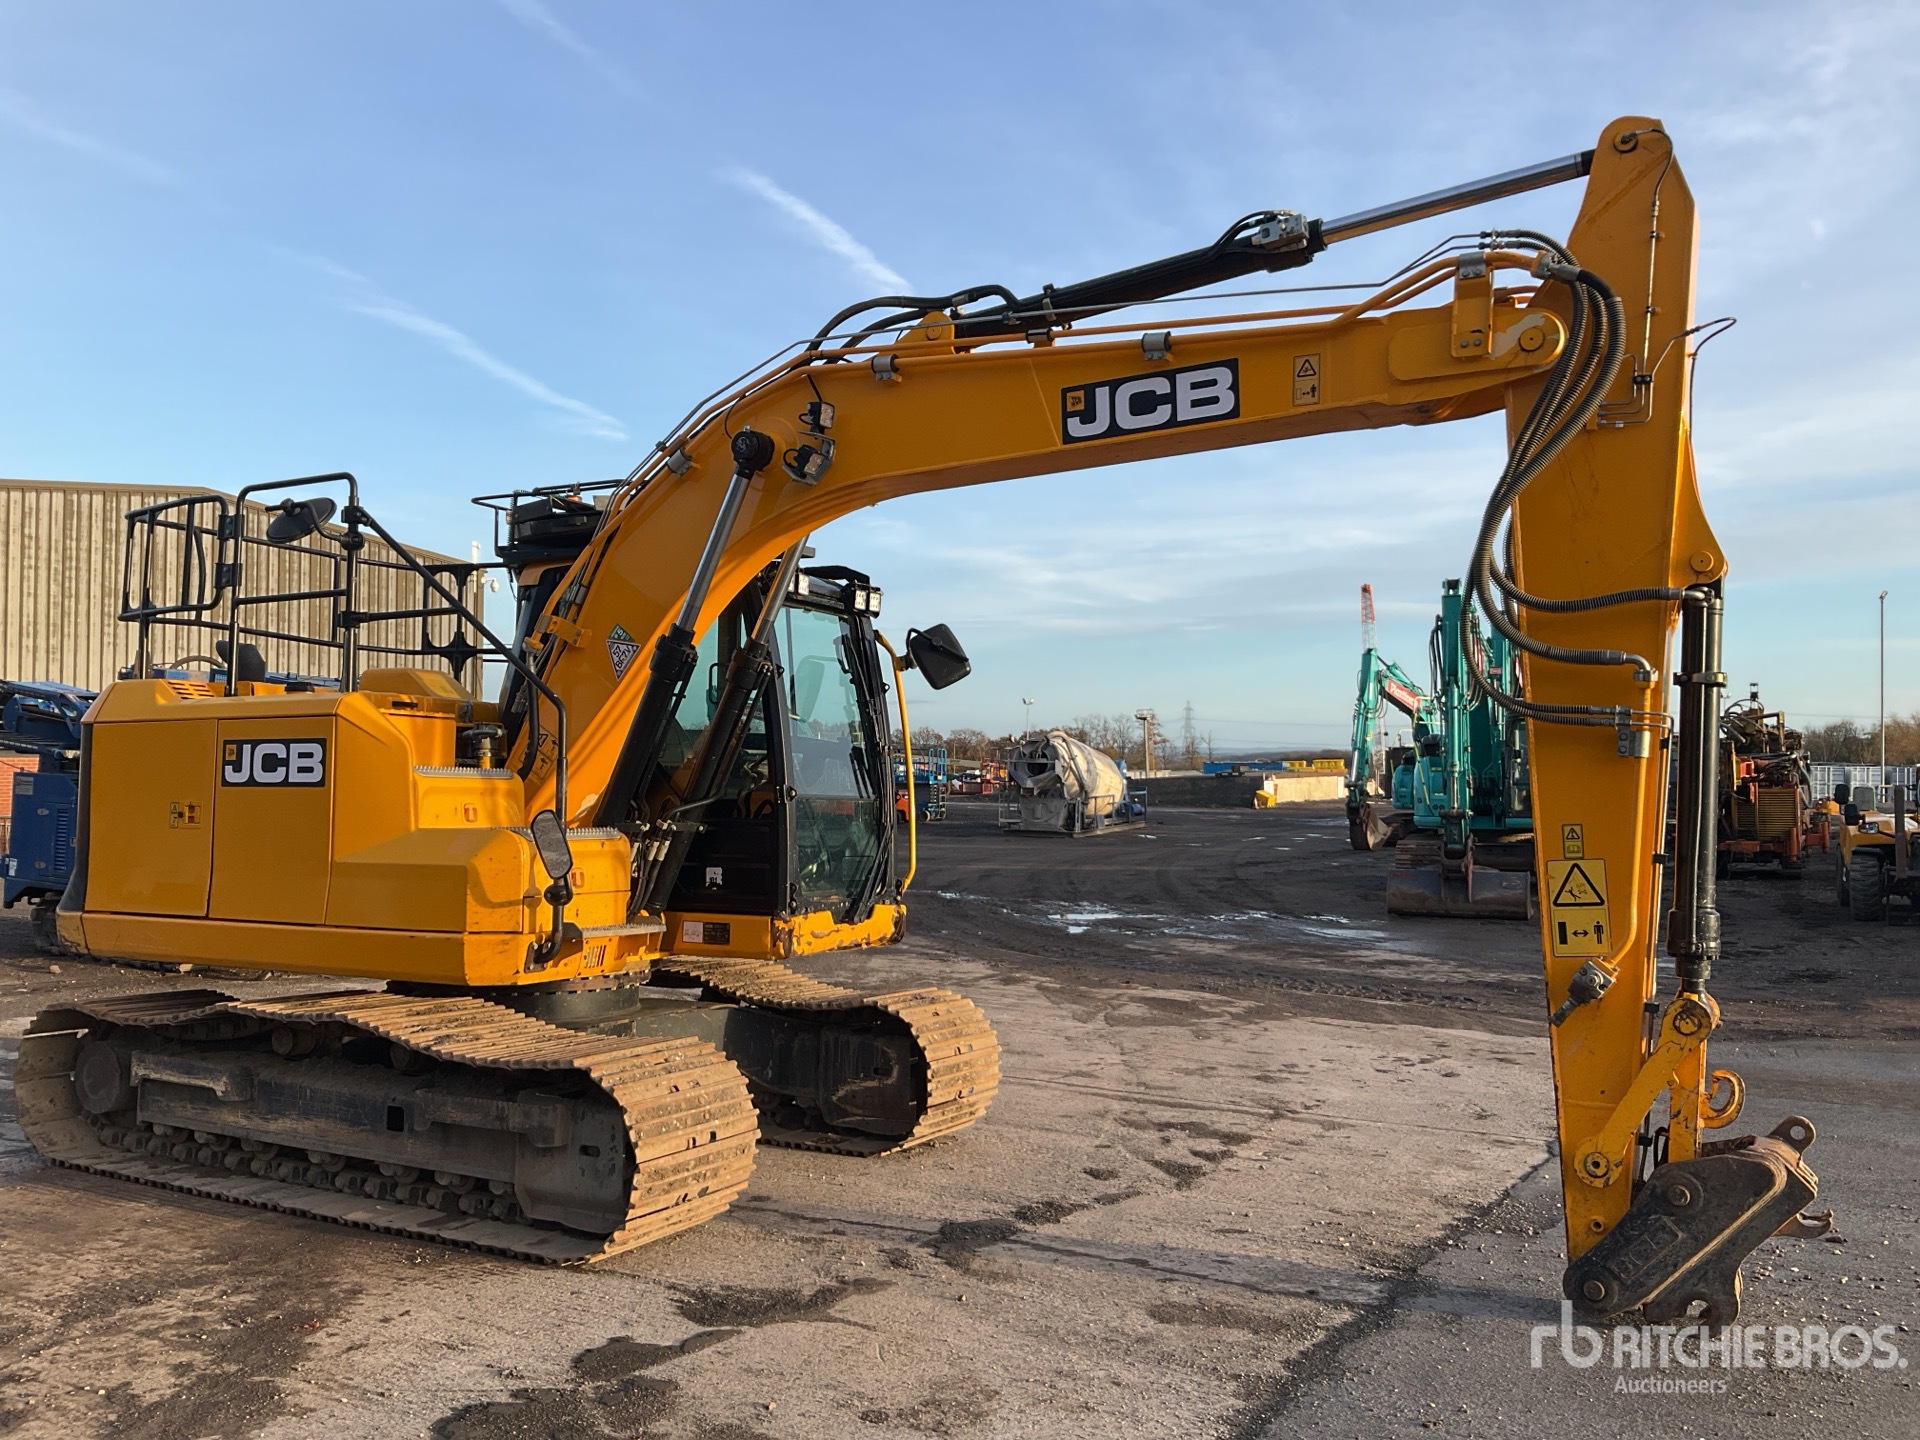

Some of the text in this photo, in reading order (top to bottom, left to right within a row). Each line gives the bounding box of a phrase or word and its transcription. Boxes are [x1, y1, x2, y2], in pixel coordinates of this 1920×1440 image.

[1067, 366, 1235, 437] JCB
[612, 644, 621, 658] 57
[224, 743, 323, 783] JCB
